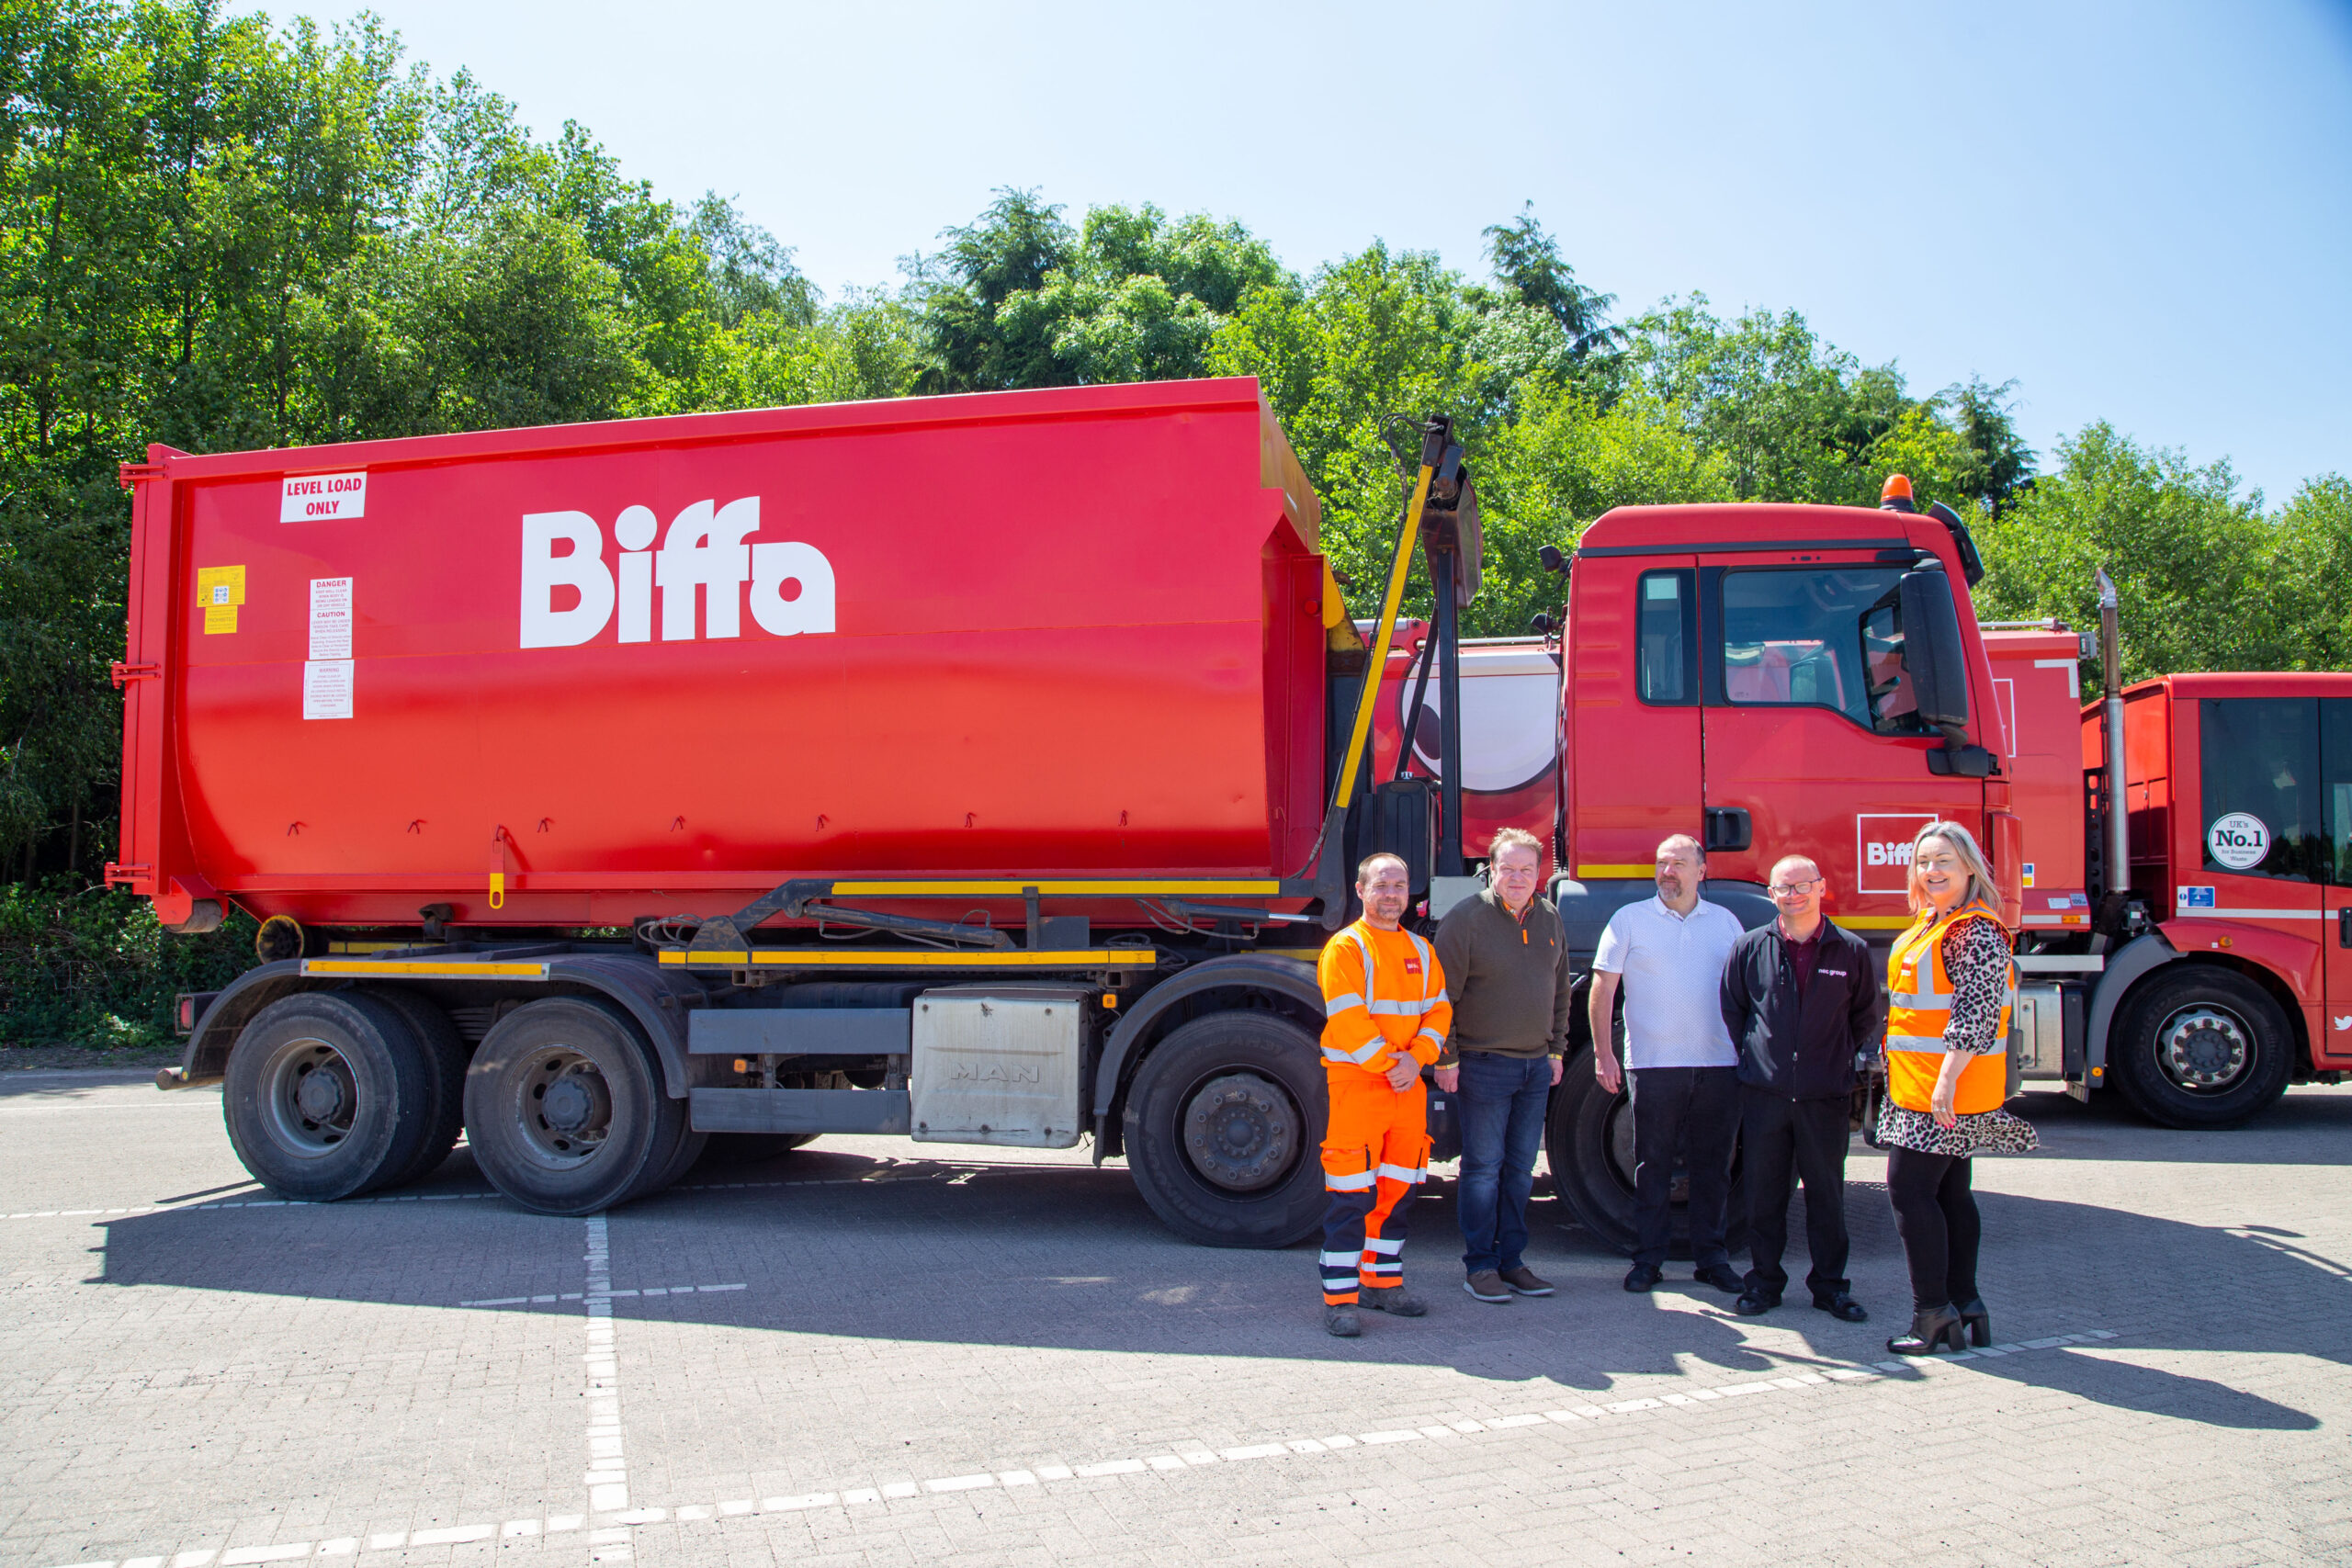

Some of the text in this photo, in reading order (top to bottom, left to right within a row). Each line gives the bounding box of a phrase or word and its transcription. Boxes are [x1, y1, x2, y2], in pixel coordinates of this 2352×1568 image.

[288, 478, 362, 496] LEVEL LOAD
[306, 501, 339, 515] ONLY
[520, 496, 836, 649] Biffa
[316, 580, 346, 588] DANGER
[2229, 820, 2249, 829] UK's
[2215, 829, 2263, 847] No.1
[1867, 842, 1913, 865] Biff
[1829, 969, 1847, 977] group
[950, 1063, 1040, 1083] MAN
